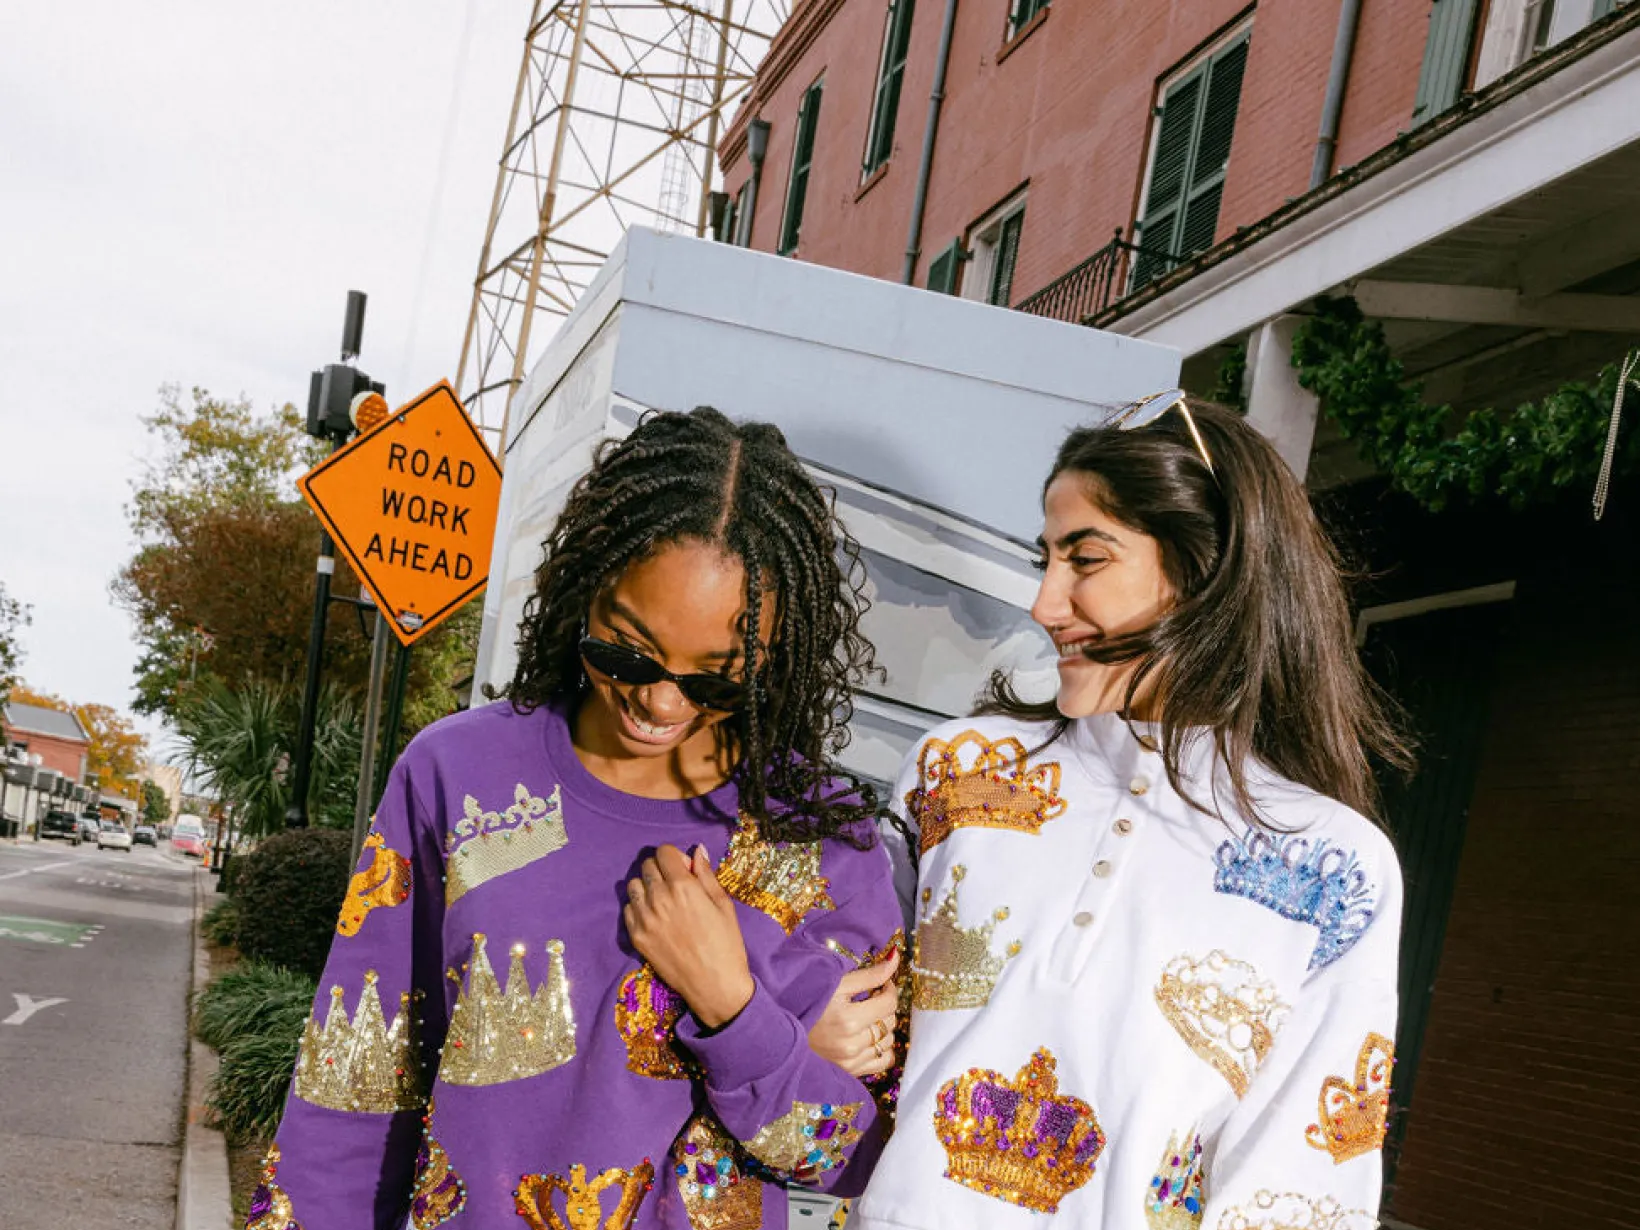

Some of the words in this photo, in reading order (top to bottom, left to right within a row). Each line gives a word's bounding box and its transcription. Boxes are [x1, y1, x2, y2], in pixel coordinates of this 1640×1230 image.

[388, 442, 476, 489] ROAD
[382, 487, 471, 536] WORK
[363, 532, 473, 581] AHEAD
